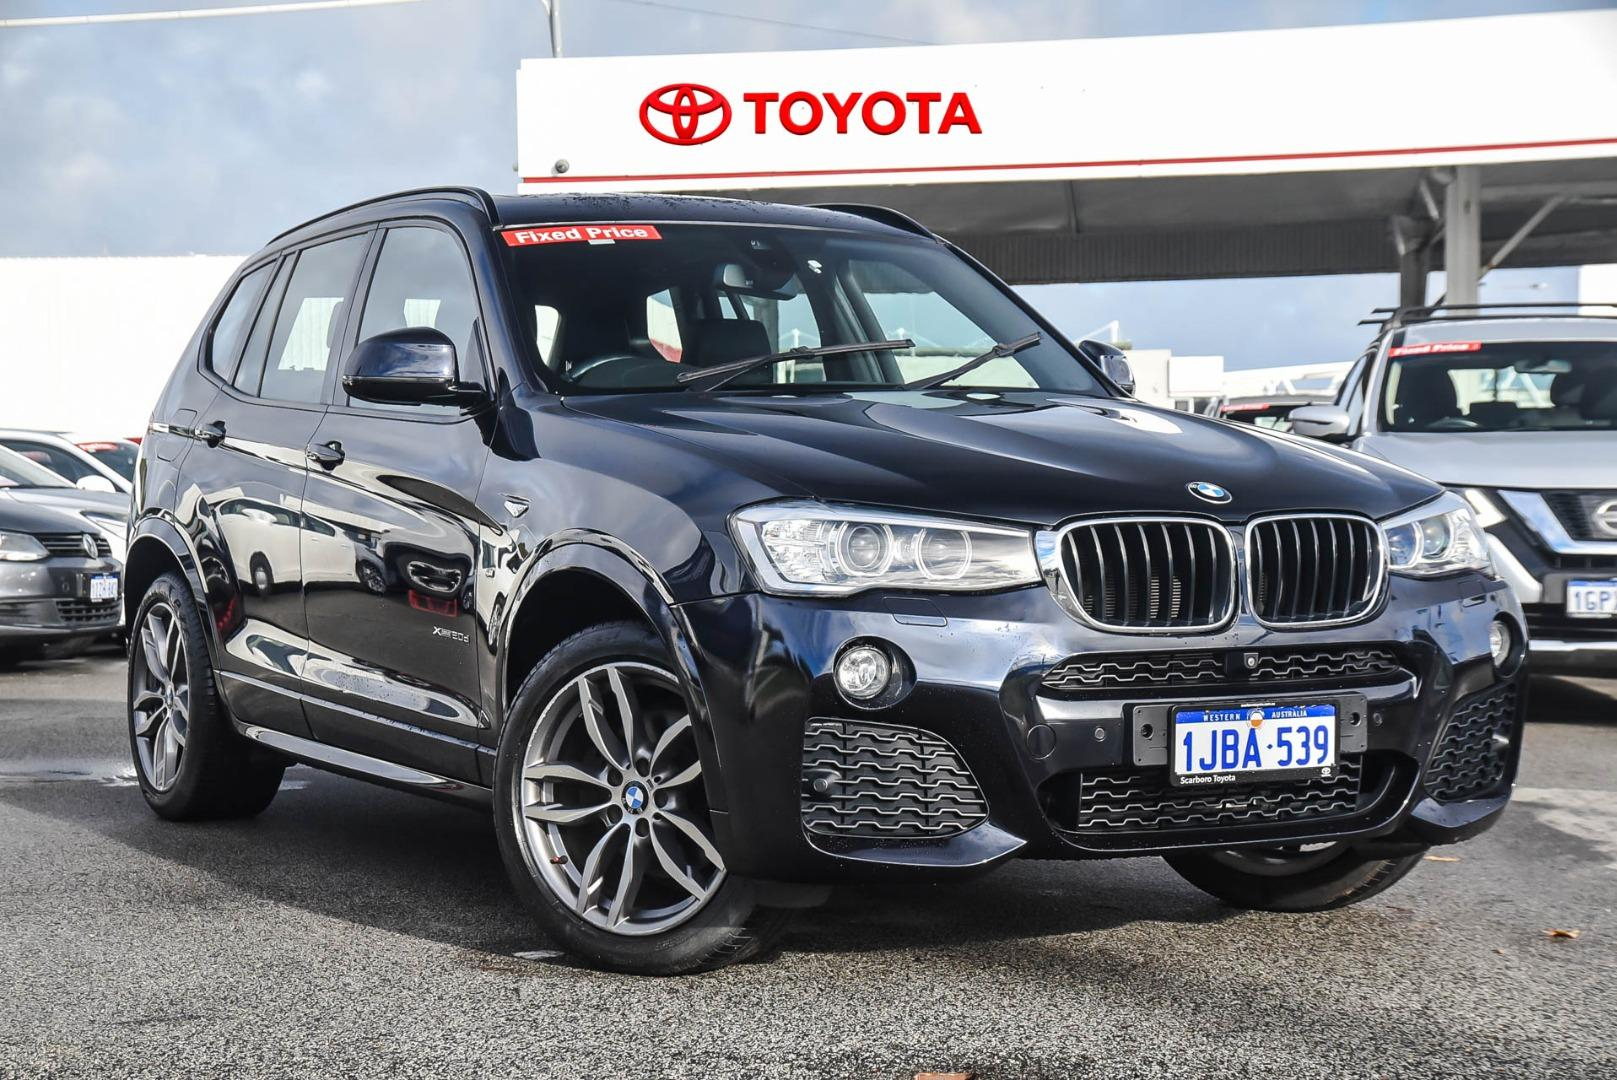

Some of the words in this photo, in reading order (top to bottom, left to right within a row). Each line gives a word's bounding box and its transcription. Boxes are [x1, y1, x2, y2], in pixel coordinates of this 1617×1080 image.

[743, 91, 983, 135] TOYOTA
[514, 227, 582, 244] Fixed
[585, 226, 649, 240] Price
[1203, 713, 1241, 722] WESTERN
[1271, 710, 1308, 719] AUSTRALIA
[1180, 775, 1212, 785] Scarboro
[1213, 774, 1236, 784] Toyota
